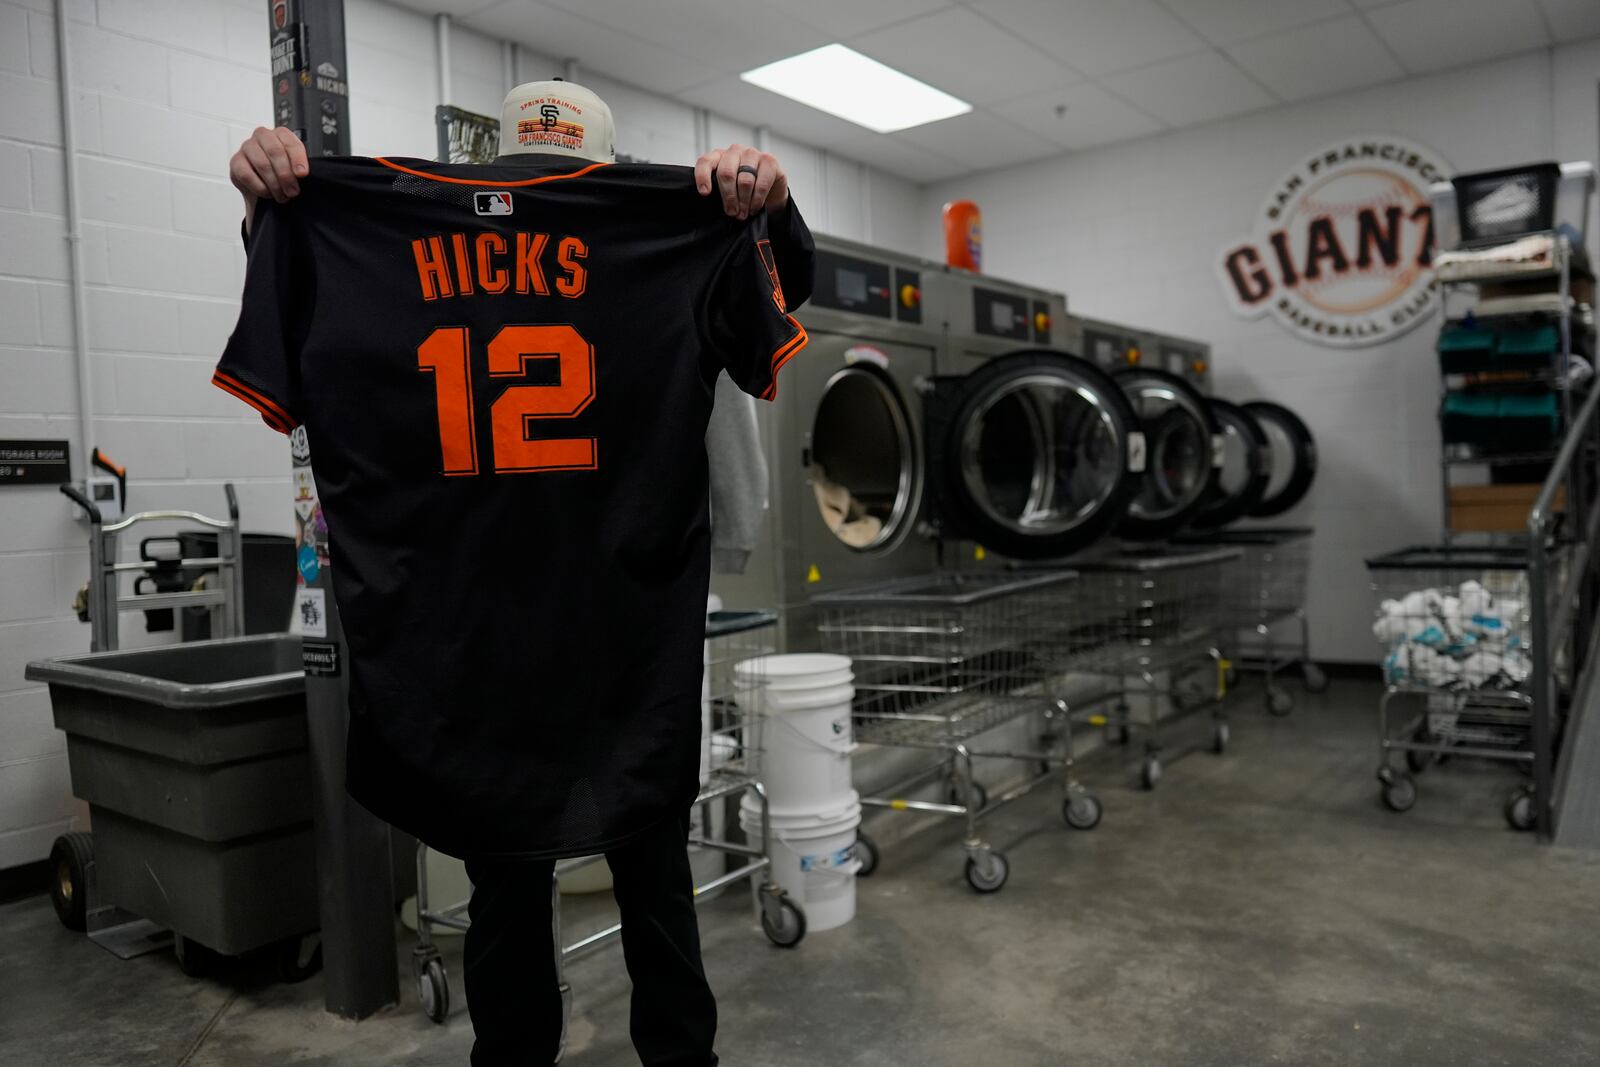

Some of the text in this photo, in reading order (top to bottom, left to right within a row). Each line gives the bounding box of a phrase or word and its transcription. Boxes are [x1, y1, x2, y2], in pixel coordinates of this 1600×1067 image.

[520, 98, 582, 115] SPRING TRAINING
[518, 132, 583, 149] SAN FRANCISCO GIANTS
[1266, 176, 1303, 219] SAN
[411, 232, 589, 301] HICKS
[1226, 205, 1437, 304] GIANT
[1277, 298, 1384, 337] BASEBALL
[416, 324, 598, 477] 12
[0, 450, 36, 460] TORAGE
